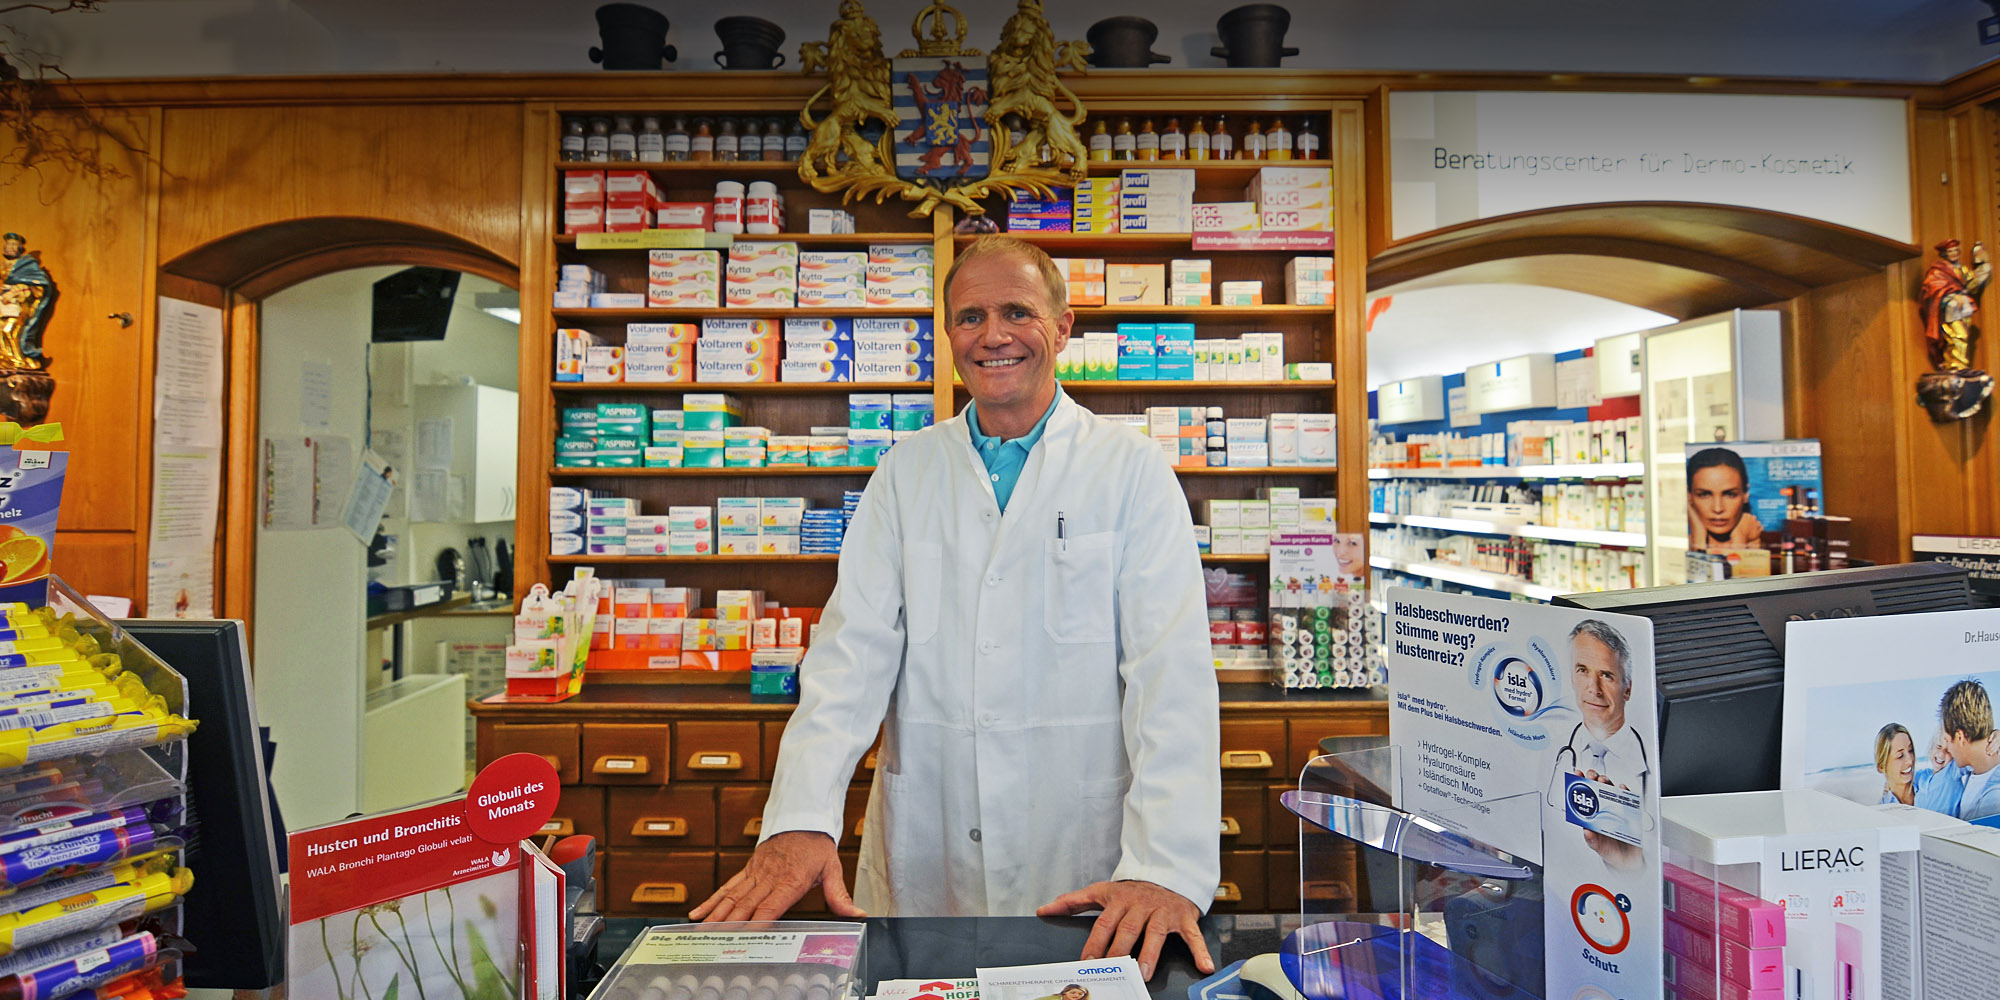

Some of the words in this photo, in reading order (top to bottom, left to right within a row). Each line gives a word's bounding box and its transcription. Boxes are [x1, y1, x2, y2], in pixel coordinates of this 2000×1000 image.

[1433, 146, 1627, 176] Beratungscenter
[1639, 152, 1672, 174] für
[1683, 153, 1855, 175] Dermo-Kosmetik
[1126, 174, 1149, 188] proff
[1123, 195, 1147, 208] proff
[1264, 191, 1299, 205] doc
[1123, 216, 1147, 229] proff
[1196, 216, 1222, 227] doc
[1264, 211, 1299, 227] doc
[651, 251, 673, 259] Kytta
[871, 247, 893, 255] Kytta
[802, 254, 823, 263] Kytta
[651, 270, 673, 278] Kytta
[728, 266, 751, 274] Kytta
[868, 265, 891, 273] Kytta
[801, 273, 822, 281] Kytta
[651, 289, 673, 297] Kytta
[728, 287, 751, 296] Kytta
[800, 289, 822, 297] Kytta
[868, 287, 891, 296] Kytta
[705, 320, 748, 329] Voltaren
[786, 319, 820, 327] Voltaren
[854, 320, 900, 329] Voltaren
[629, 325, 667, 333] Voltaren
[626, 344, 664, 352] Voltaren
[699, 339, 742, 348] Voltaren
[788, 341, 821, 349] Voltaren
[856, 341, 901, 351] Voltaren
[627, 363, 664, 371] Voltaren
[699, 361, 742, 370] Voltaren
[783, 360, 817, 368] Voltaren
[856, 362, 901, 372] Voltaren
[605, 408, 637, 416] ASPIRIN
[563, 441, 594, 449] ASPIRIN
[605, 440, 636, 448] ASPIRIN
[1771, 445, 1817, 455] LIERAC
[1395, 601, 1510, 632] Halsbeschwerden?
[1395, 621, 1439, 643] Stimme
[1442, 631, 1476, 650] weg?
[1395, 639, 1465, 667] Hustenreiz?
[1411, 695, 1425, 706] med
[1508, 693, 1527, 703] Formel
[1397, 701, 1407, 710] Mit
[1407, 704, 1420, 714] dem
[1420, 706, 1434, 718] Plus
[1434, 710, 1444, 720] bei
[1444, 713, 1503, 737] Halsbeschwerden.
[75, 723, 113, 735] Banane
[1422, 740, 1491, 771] Hydrogel-Komplex
[1422, 754, 1476, 780] Hyaluronsäure
[1423, 769, 1460, 793] Isländisch
[1461, 779, 1483, 798] Moos
[477, 786, 521, 808] Globuli
[524, 781, 544, 795] des
[488, 799, 535, 820] Monats
[307, 837, 358, 857] Husten
[363, 829, 389, 845] und
[394, 815, 461, 839] Bronchitis
[50, 834, 101, 853] Schmelz
[27, 844, 100, 868] Traubenzucker
[306, 865, 336, 878] WALA
[339, 857, 374, 872] Bronchi
[376, 846, 416, 863] Plantago
[417, 840, 448, 853] Globuli
[450, 834, 473, 847] velati
[1781, 846, 1864, 872] LIERAC
[470, 857, 489, 866] WALA
[452, 862, 490, 876] Arzneimittel
[62, 896, 98, 913] Zitrone
[1581, 948, 1620, 974] Schutz
[1725, 942, 1734, 978] LIERAC
